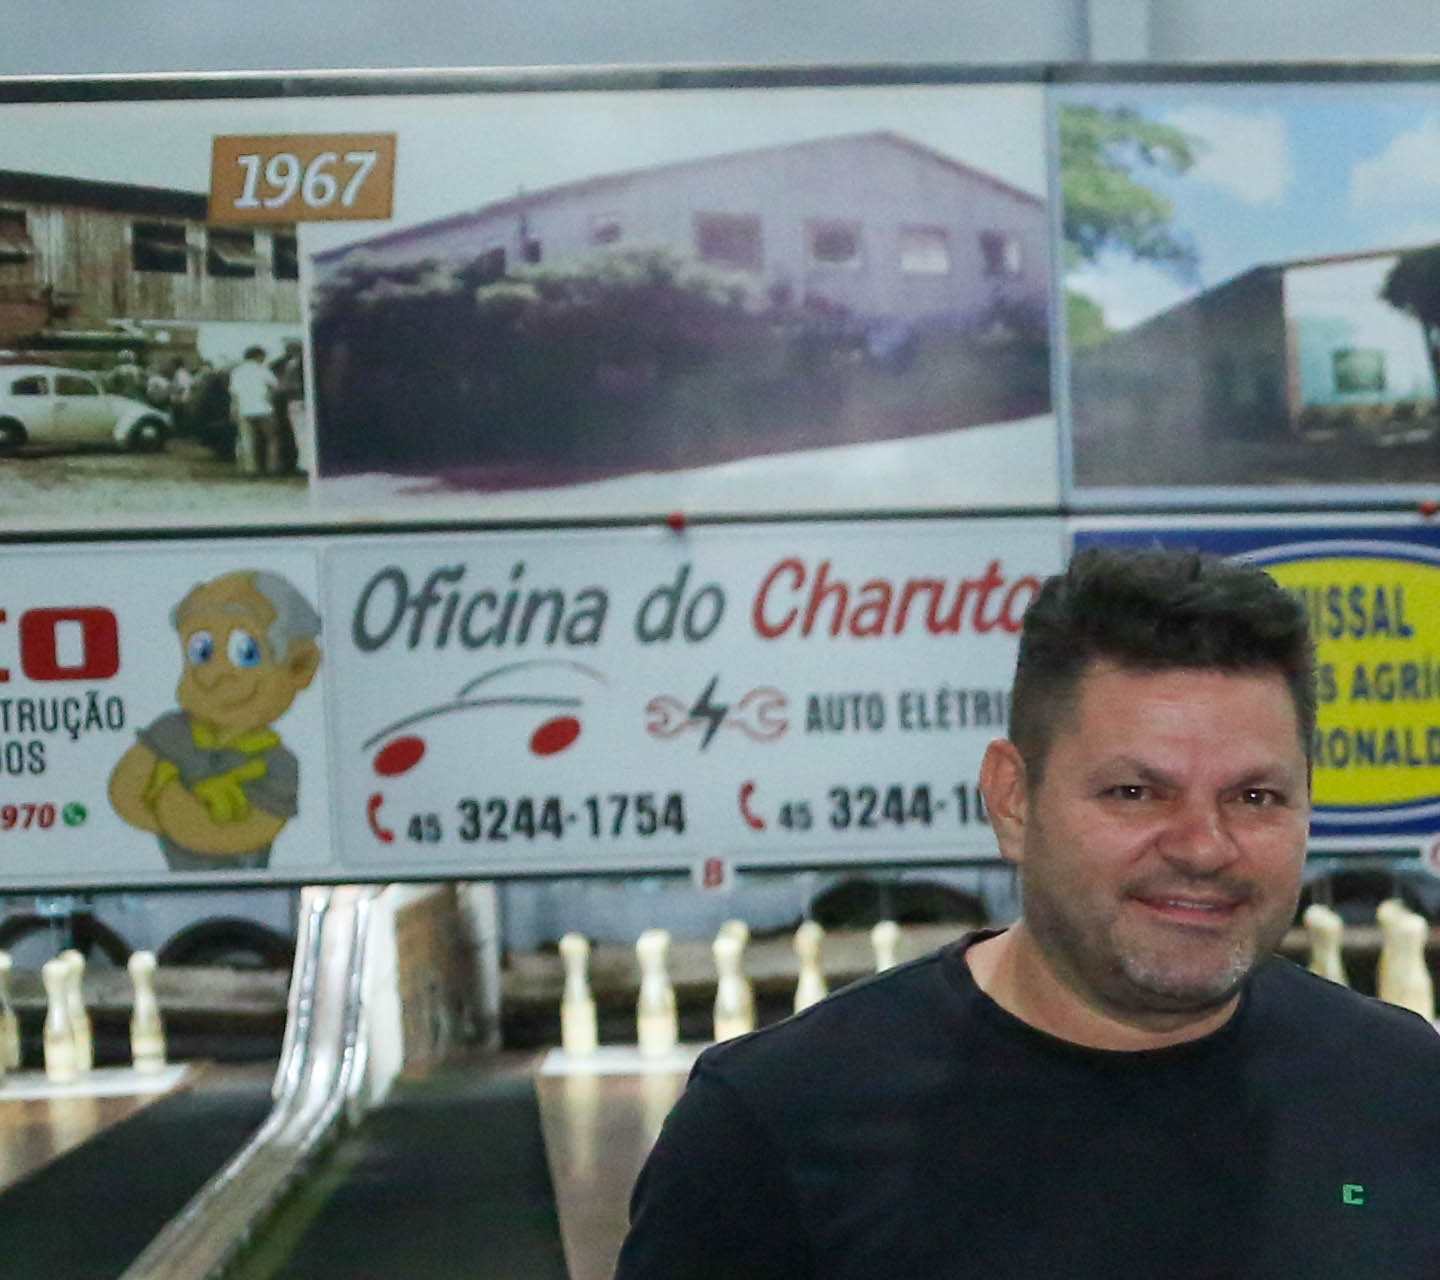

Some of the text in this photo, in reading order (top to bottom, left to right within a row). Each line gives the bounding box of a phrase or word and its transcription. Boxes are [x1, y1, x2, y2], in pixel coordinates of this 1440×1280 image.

[233, 151, 381, 212] 1967
[352, 561, 609, 653] Oficina
[634, 563, 725, 643] do
[0, 606, 120, 683] O
[804, 691, 887, 735] AUTO
[0, 740, 46, 776] OS
[457, 792, 687, 843] 3244-1754
